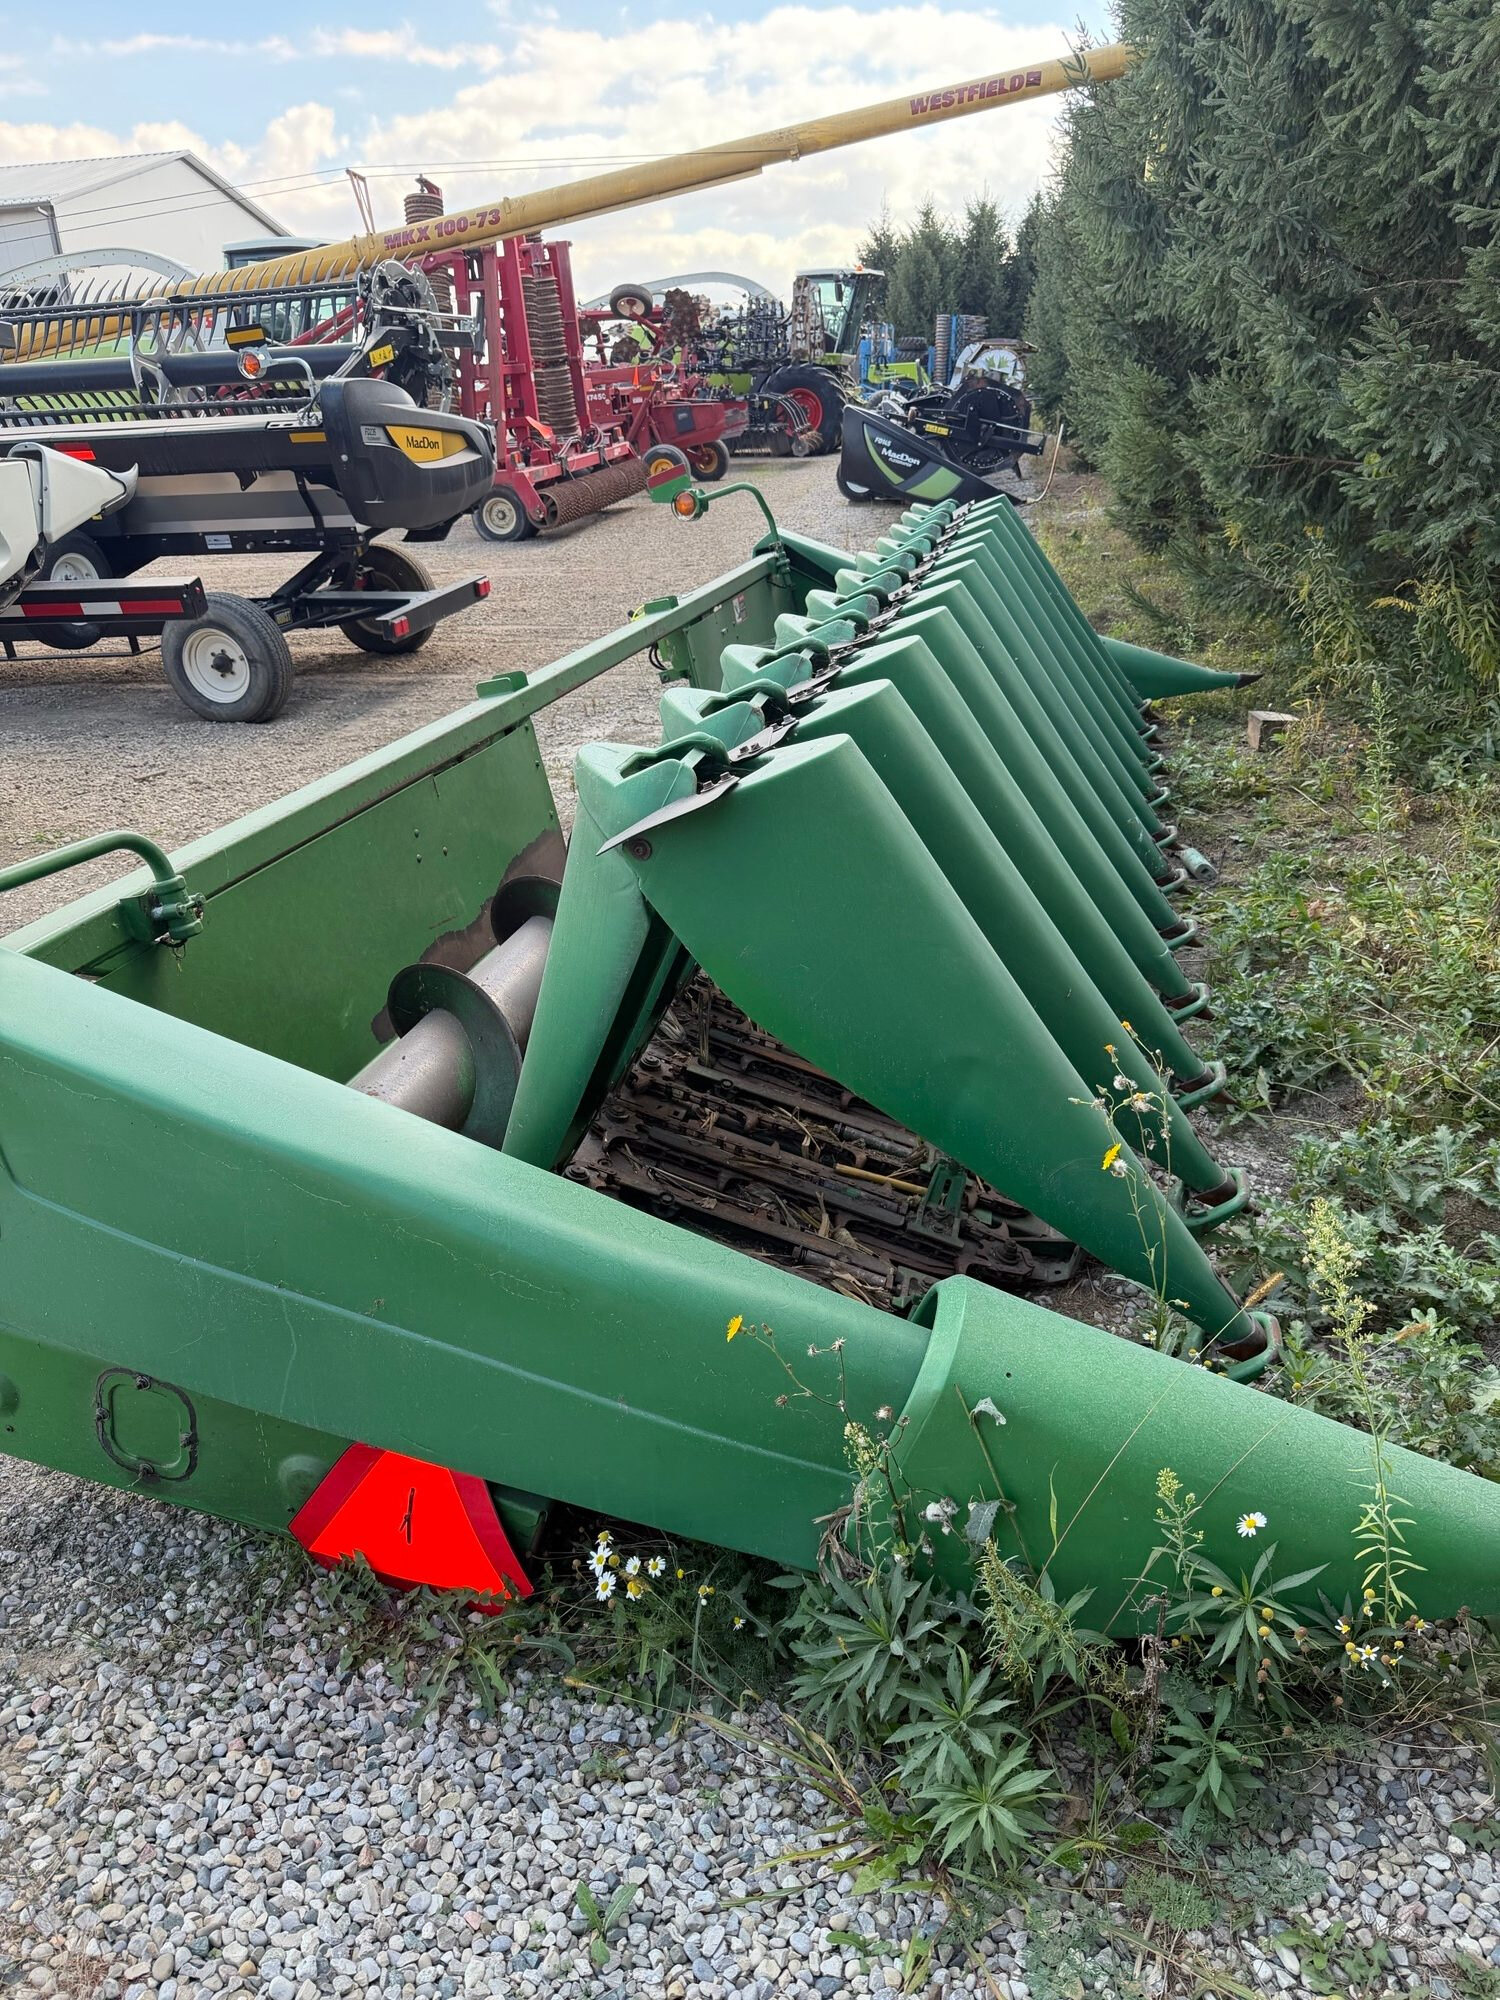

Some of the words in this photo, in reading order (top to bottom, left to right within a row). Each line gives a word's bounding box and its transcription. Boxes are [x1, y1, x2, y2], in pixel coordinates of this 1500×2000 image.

[910, 74, 1024, 115] WESTFIELD
[384, 226, 431, 250] MKX
[435, 208, 500, 238] 100-73
[406, 436, 439, 449] MacDon
[881, 447, 920, 465] MacDon
